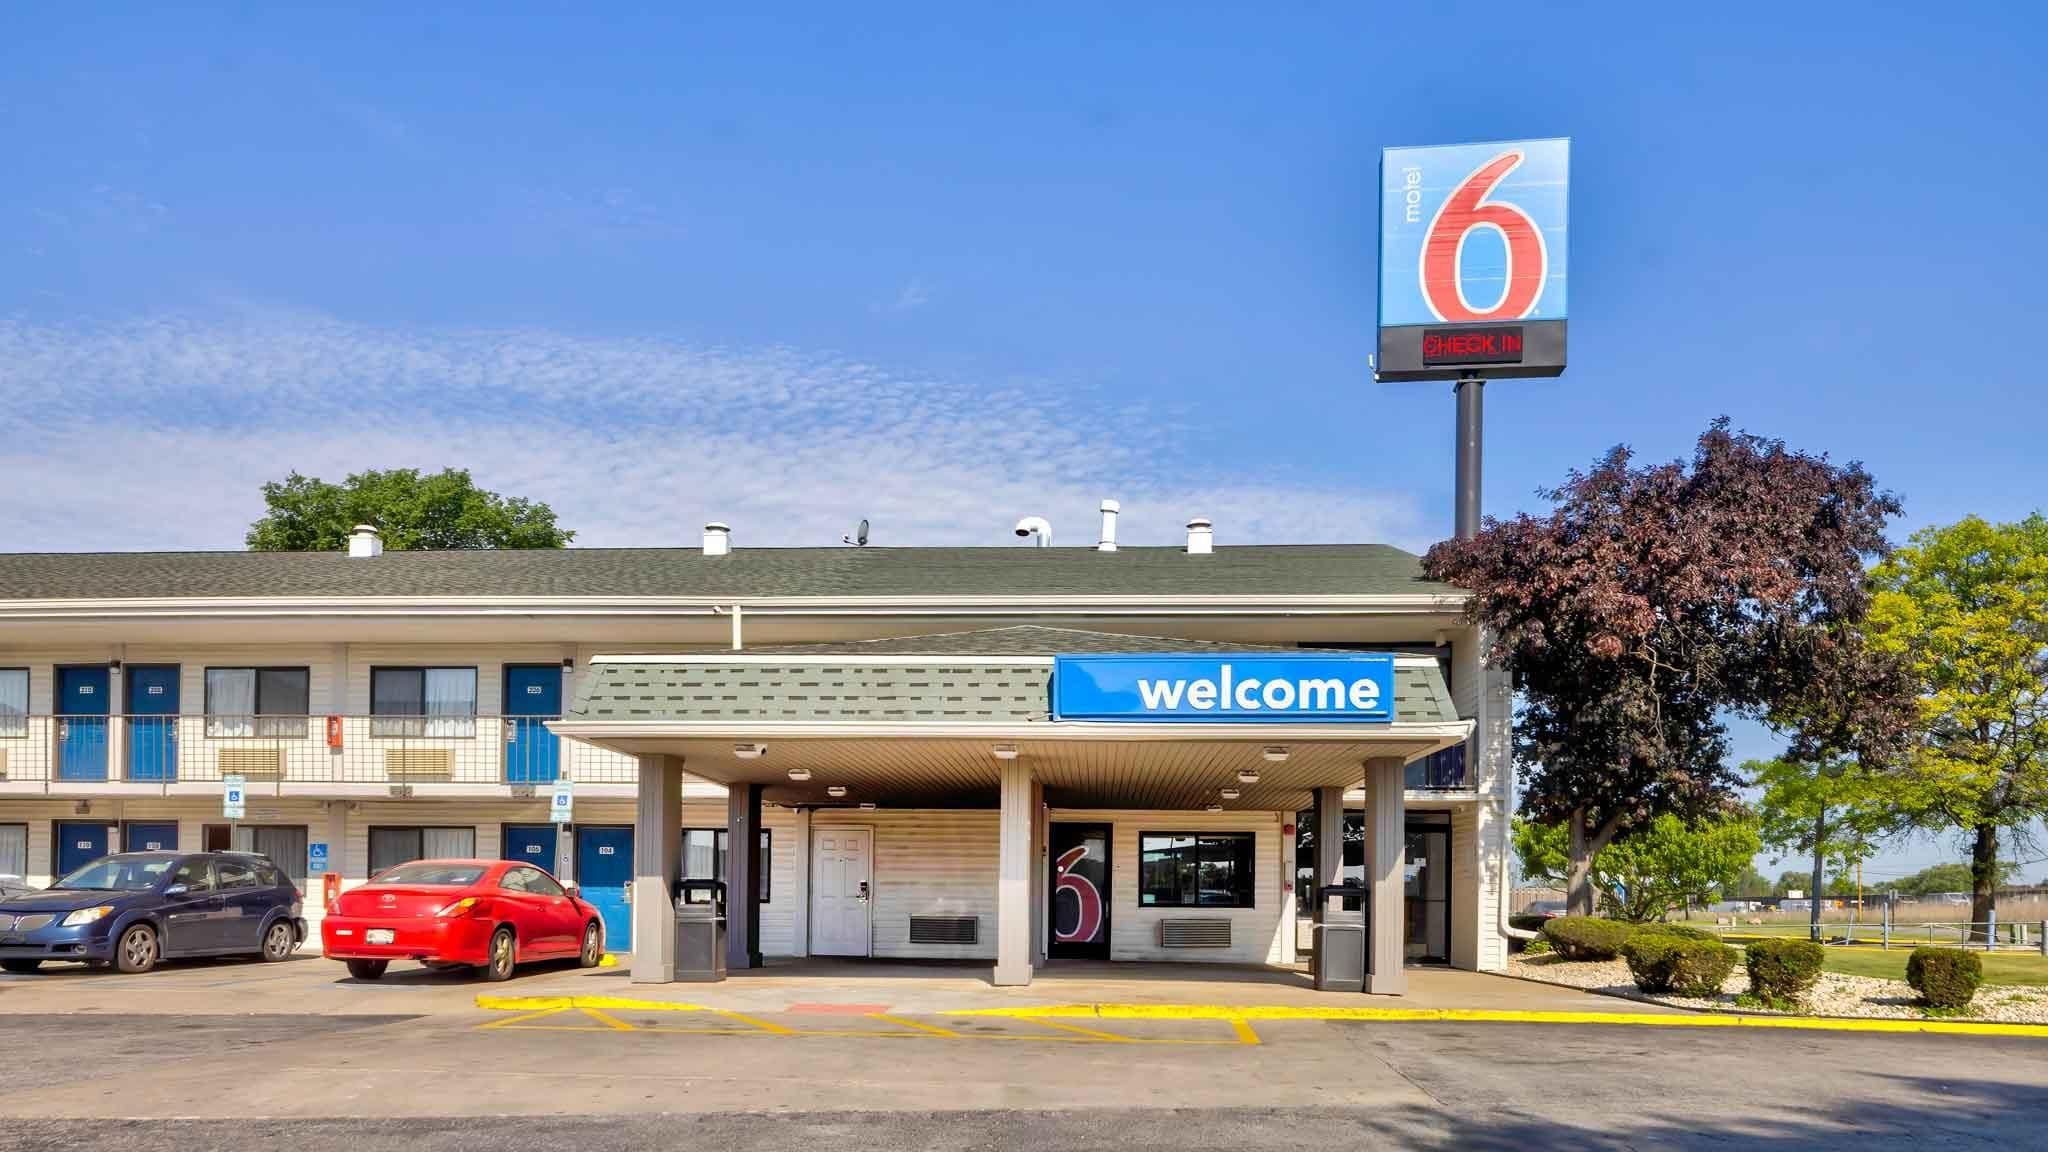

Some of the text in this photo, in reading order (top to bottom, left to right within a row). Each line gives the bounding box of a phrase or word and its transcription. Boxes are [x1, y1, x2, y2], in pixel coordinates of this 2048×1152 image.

[1419, 151, 1548, 322] 6
[1424, 335, 1522, 354] CHECK IN
[1138, 664, 1380, 711] welcome
